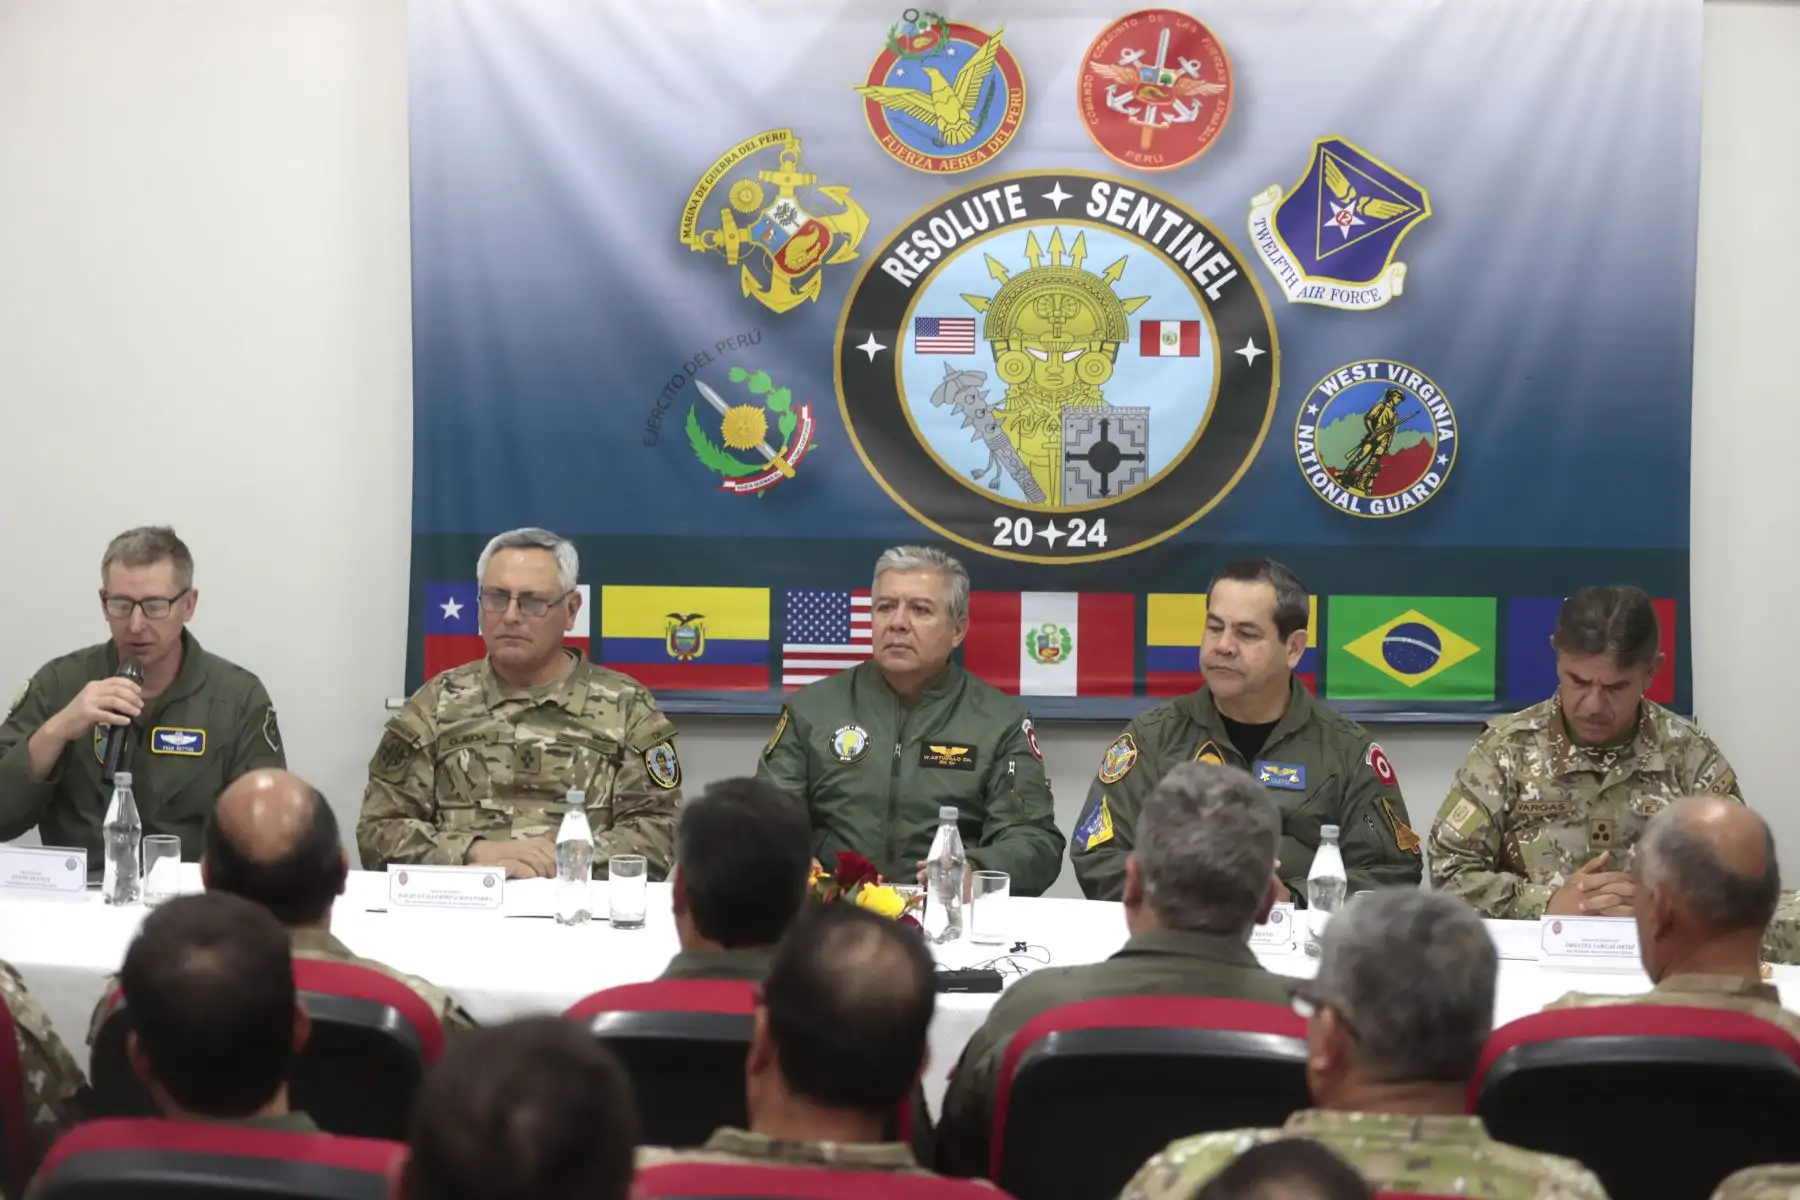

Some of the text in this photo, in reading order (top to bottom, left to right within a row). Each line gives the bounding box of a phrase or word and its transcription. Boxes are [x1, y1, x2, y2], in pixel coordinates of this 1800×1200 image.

[1084, 74, 1099, 126] COMANDO
[1148, 14, 1165, 23] DE
[1176, 18, 1198, 33] LAS
[882, 87, 1022, 171] FUERZA AEREA DEL PERU
[1124, 149, 1164, 164] PERU
[682, 131, 787, 239] MARINA DE GUERRA DEL PERU
[1337, 210, 1352, 226] 12
[880, 181, 1239, 301] RESOLUTE SENTINEL
[1254, 217, 1382, 305] TWELFTH AIR FORCE
[642, 373, 686, 447] EJERCITO
[683, 350, 716, 377] DEL
[1318, 363, 1454, 442] WEST VIRGINIA
[1298, 424, 1441, 514] NATIONAL GUARD
[993, 516, 1108, 548] 20 24
[1517, 802, 1566, 812] VARGAS
